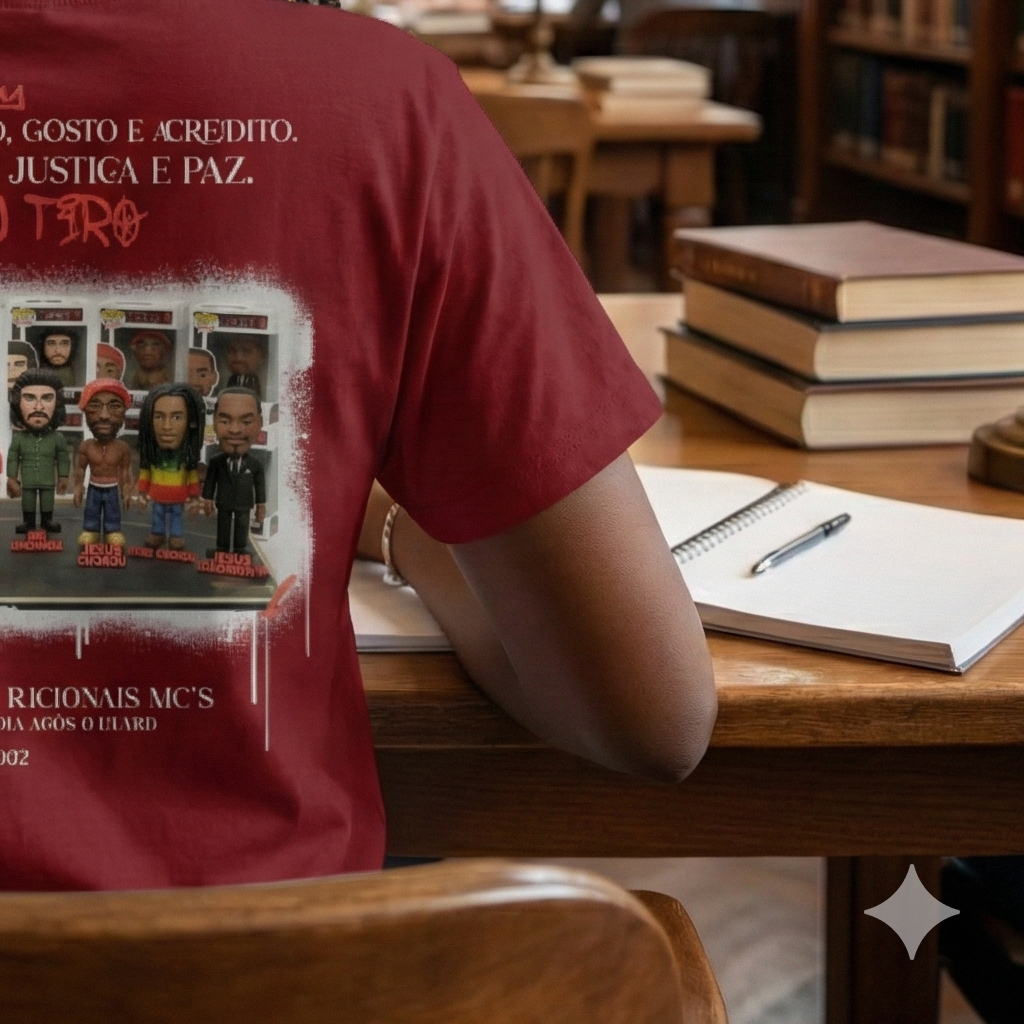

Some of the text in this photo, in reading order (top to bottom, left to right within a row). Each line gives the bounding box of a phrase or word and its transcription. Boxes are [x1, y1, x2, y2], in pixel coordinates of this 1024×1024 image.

[22, 118, 119, 143] GOSTO
[128, 119, 145, 143] E
[152, 118, 299, 145] ACREDITO.
[152, 156, 171, 184] E
[183, 155, 254, 185] PAZ.
[7, 686, 140, 709] RICIONAIS
[150, 686, 215, 709] MC'S
[81, 716, 95, 732] O
